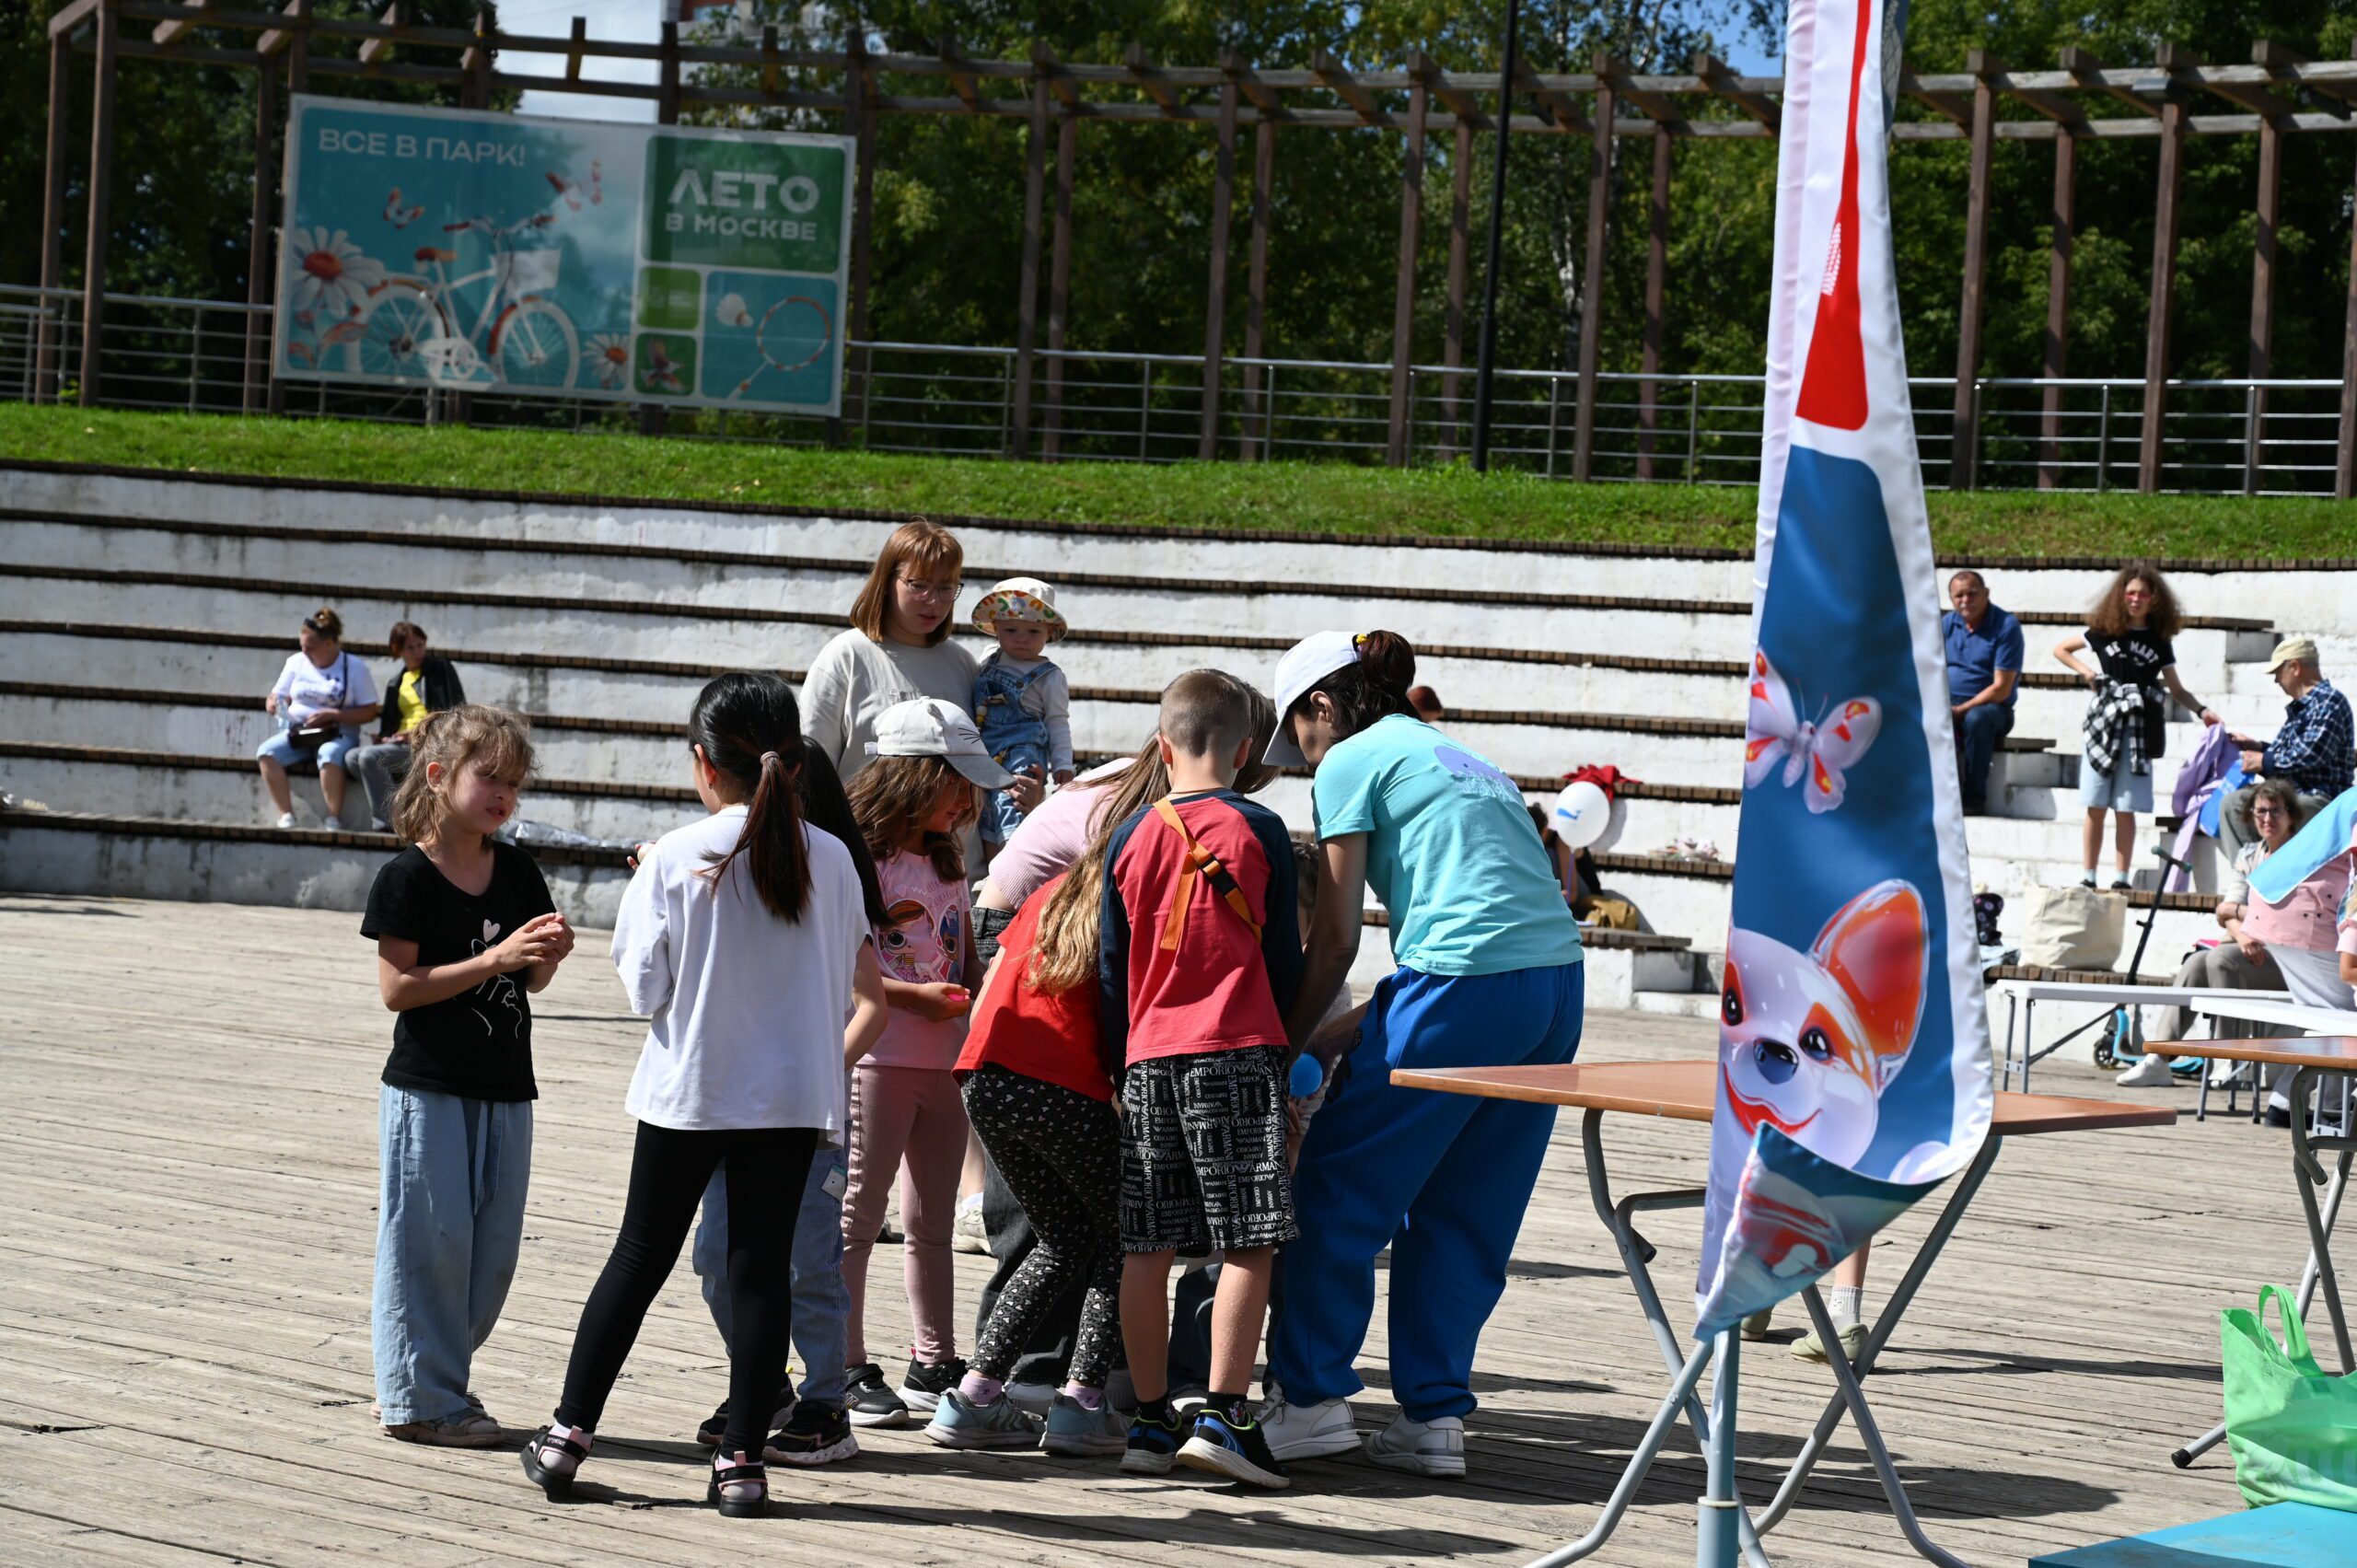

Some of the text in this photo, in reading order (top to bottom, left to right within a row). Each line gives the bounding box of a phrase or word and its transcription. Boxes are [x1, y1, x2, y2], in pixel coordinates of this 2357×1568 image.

[319, 128, 526, 166] ВСЕ В ПАРК!
[668, 168, 819, 214] ЛЕТО
[665, 213, 818, 241] В МОСКВЕ
[1190, 1066, 1236, 1077] EMPORIO
[1140, 1064, 1152, 1147] EMPORIO ARMANI
[1227, 1074, 1240, 1113] EMPORIO
[1267, 1074, 1281, 1113] EMPORIO
[1144, 1161, 1154, 1200] EMPORIO
[1249, 1161, 1279, 1173] ARMAN
[1206, 1216, 1230, 1225] ARMA
[1242, 1211, 1283, 1224] EMPORIO
[1232, 1224, 1243, 1249] ARMA
